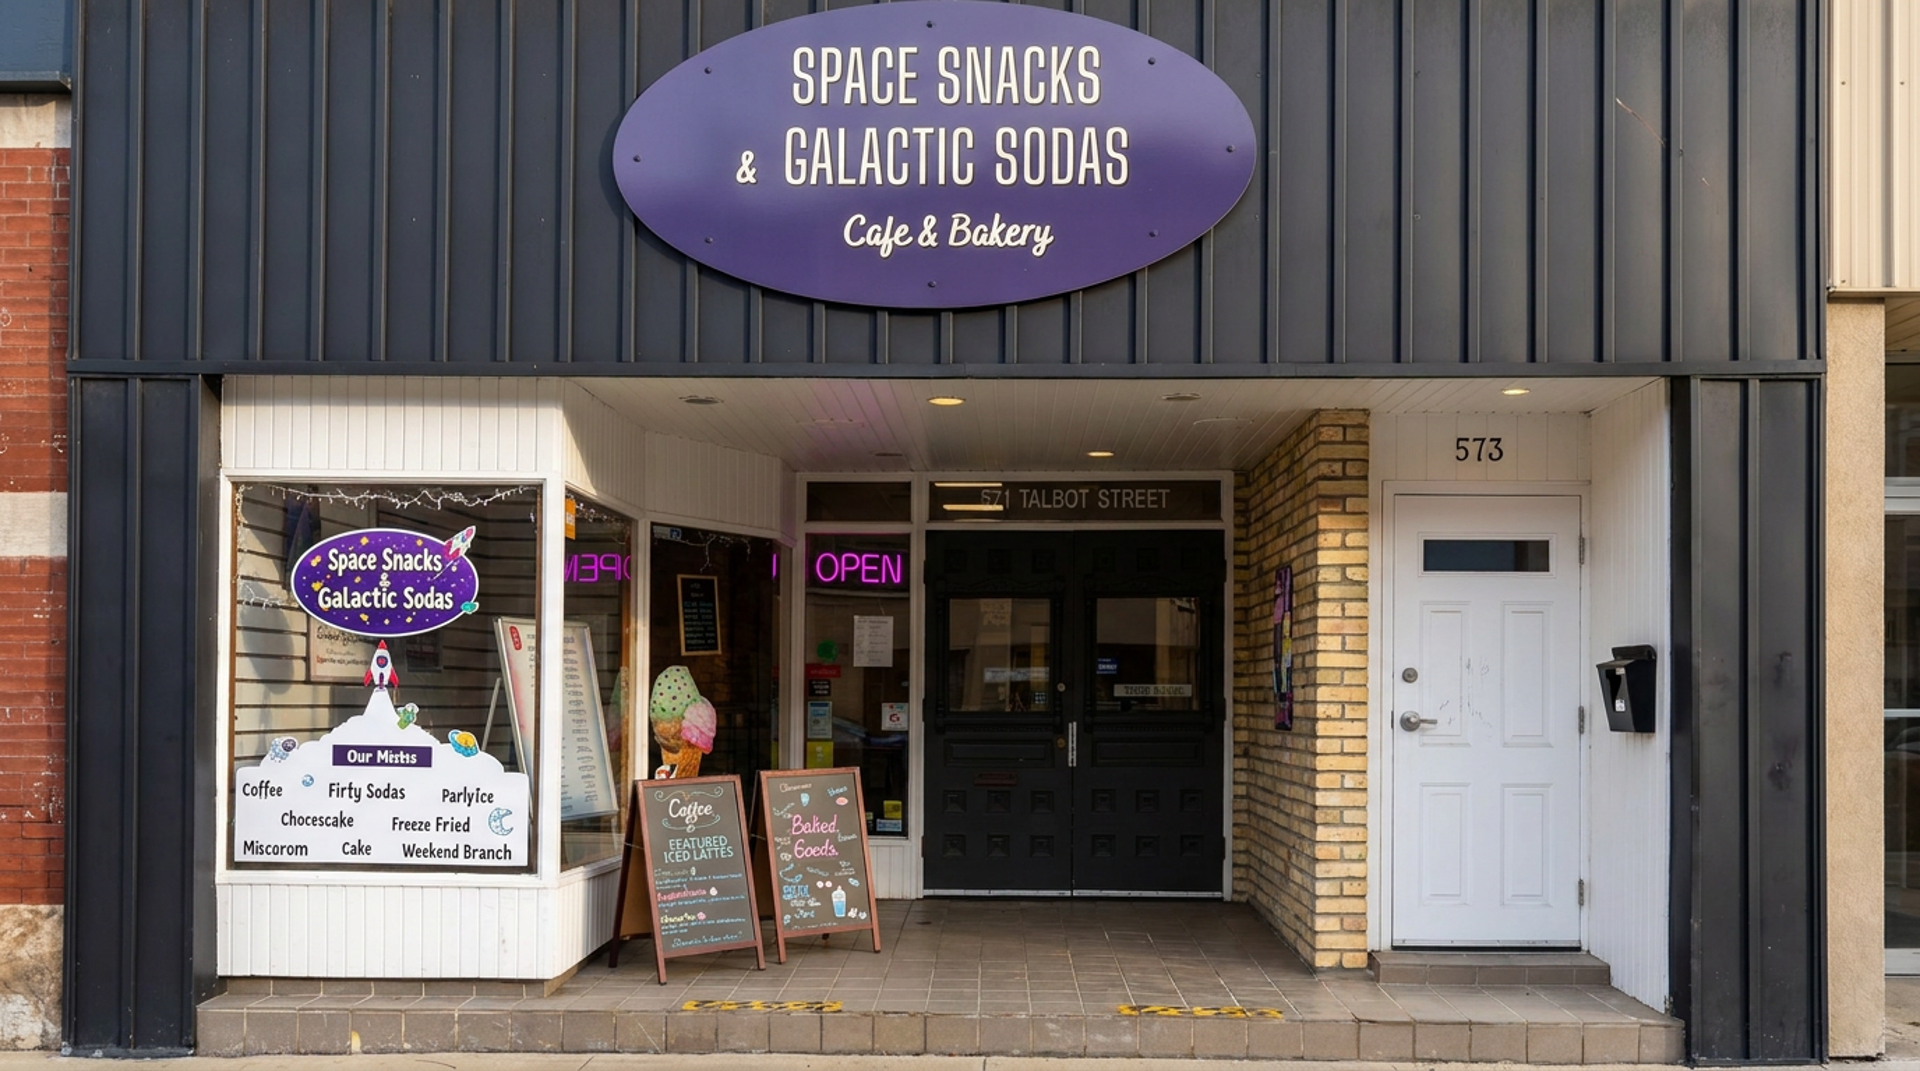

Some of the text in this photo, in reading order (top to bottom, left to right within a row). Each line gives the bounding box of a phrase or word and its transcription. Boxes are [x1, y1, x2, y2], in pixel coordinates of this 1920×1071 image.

[792, 45, 1102, 105] SPACE SNACKS
[736, 126, 1129, 187] & GALACTIC SODAS
[843, 212, 1054, 258] Cafe & Bakery
[1455, 437, 1504, 462] 573
[1019, 489, 1089, 509] TALBOT
[1098, 489, 1170, 509] STREET
[327, 547, 443, 577] Space Snacks
[815, 552, 902, 584] OPEN
[317, 586, 454, 610] Galactic Sodas
[347, 749, 373, 764] Our
[242, 780, 283, 799] Coffee
[366, 782, 406, 800] Sodas
[281, 810, 354, 828] Chocescake
[392, 816, 471, 833] Freeze Fried
[341, 838, 372, 856] Cake
[402, 842, 512, 860] Weekend Branch
[664, 846, 734, 863] ICED LATTES
